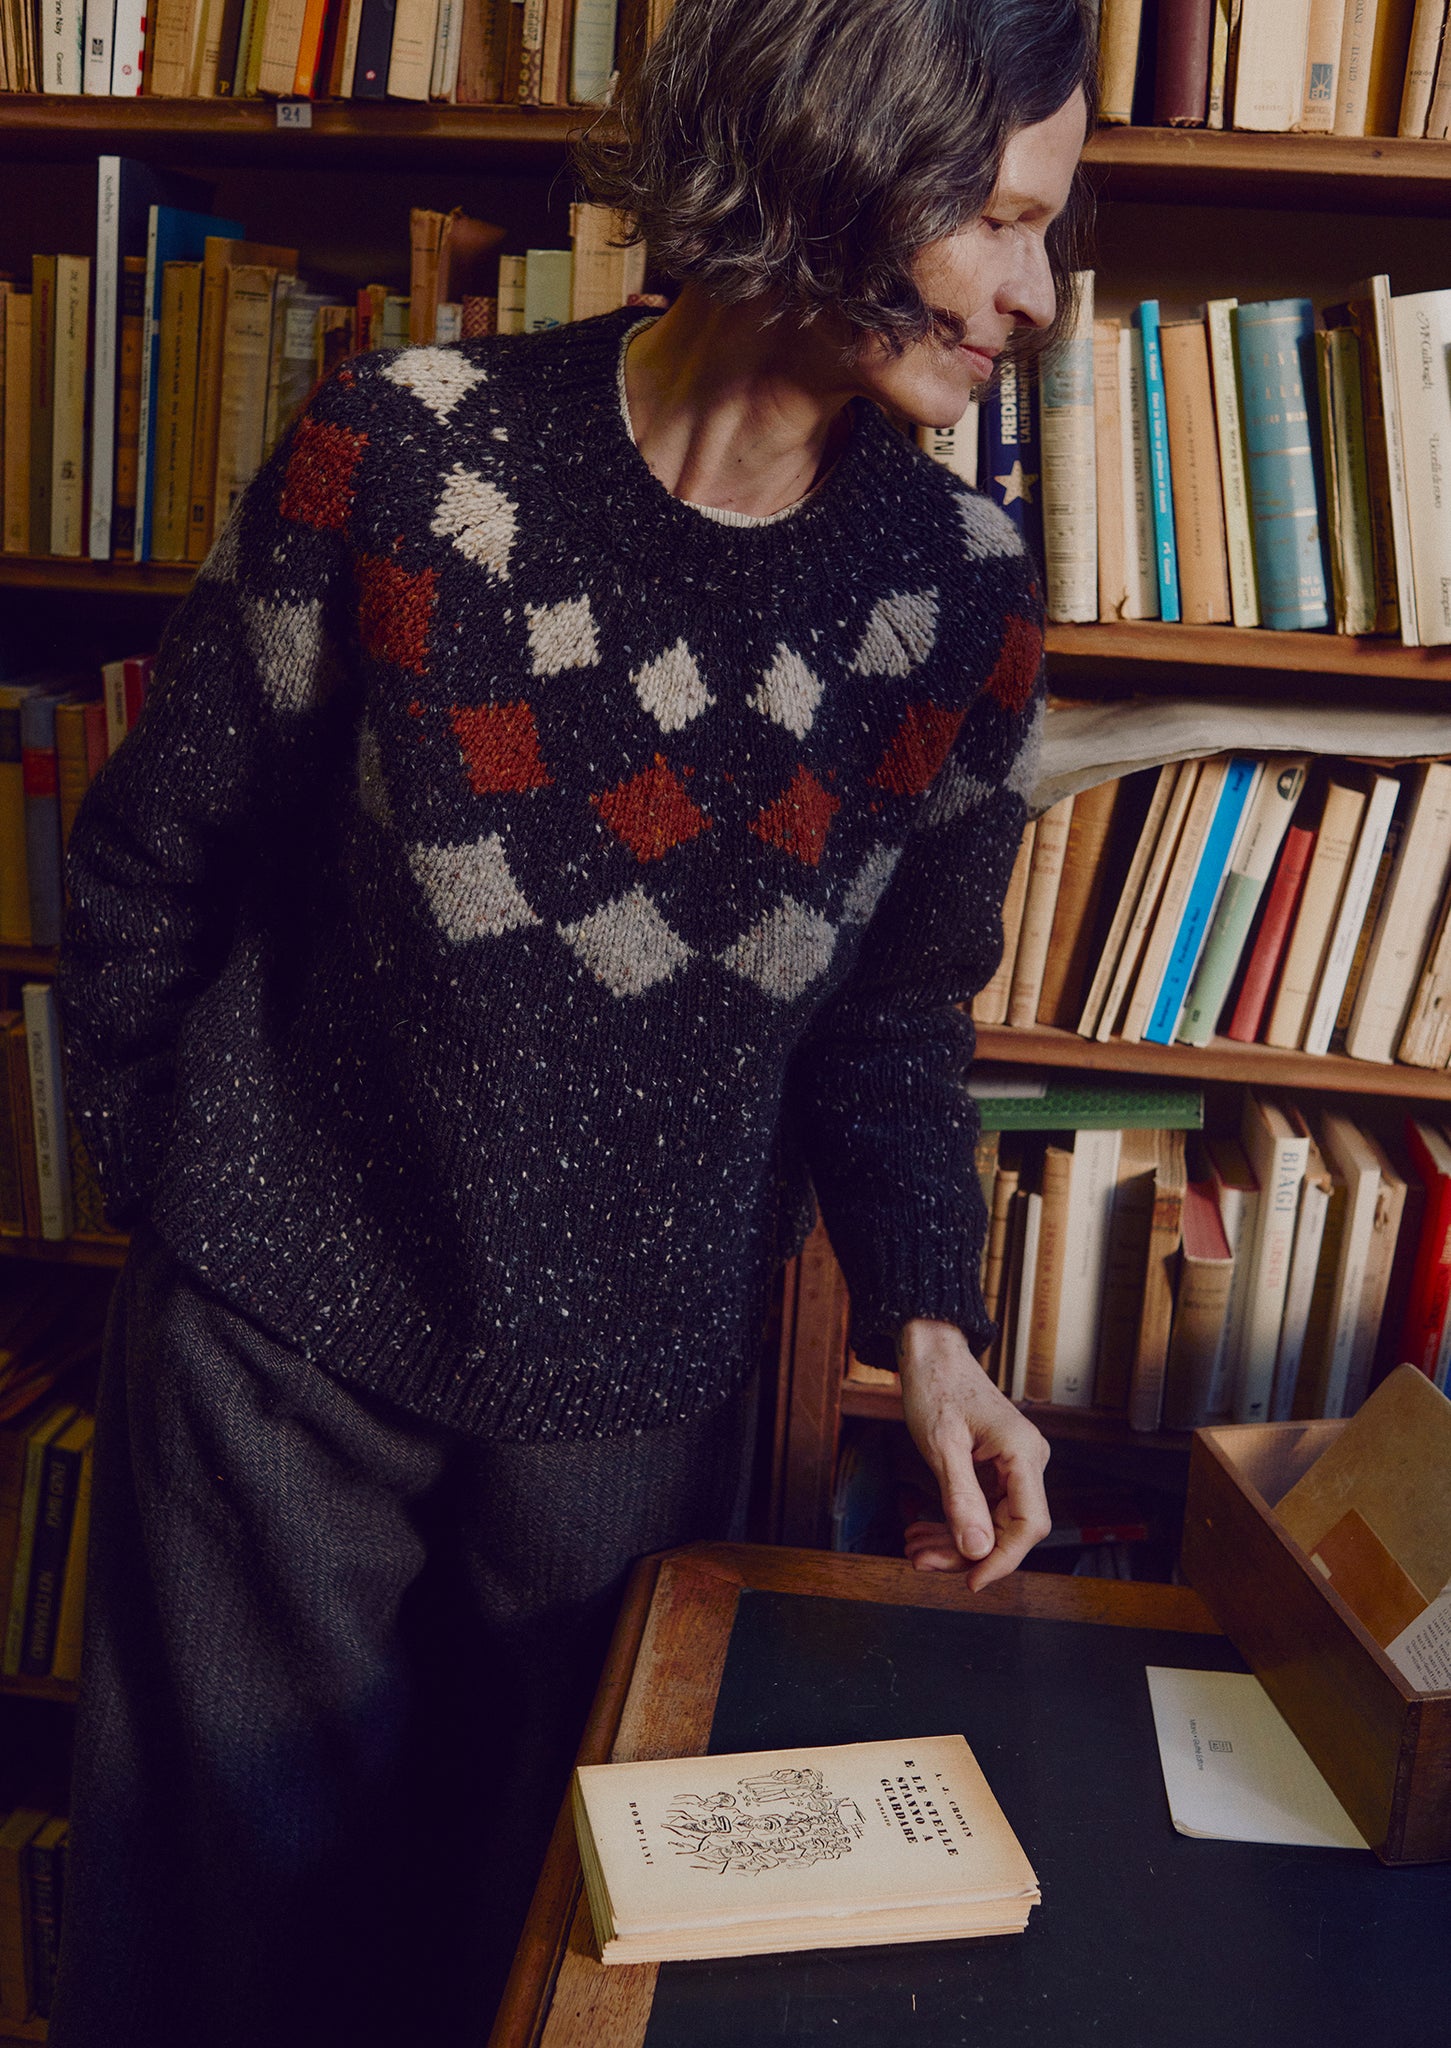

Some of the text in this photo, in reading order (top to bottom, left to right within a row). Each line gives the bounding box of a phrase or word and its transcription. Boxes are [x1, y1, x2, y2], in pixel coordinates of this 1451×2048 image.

[54, 17, 63, 36] Nay
[56, 52, 64, 85] Grasset
[282, 106, 300, 122] 21
[1275, 1152, 1299, 1211] BIAGI
[628, 1801, 654, 1865] BOMPIANI
[880, 1778, 918, 1844] GUARDARE
[896, 1776, 933, 1842] STANNO A
[904, 1760, 959, 1856] E LE STELLE
[935, 1772, 974, 1838] A. J. CRONIN
